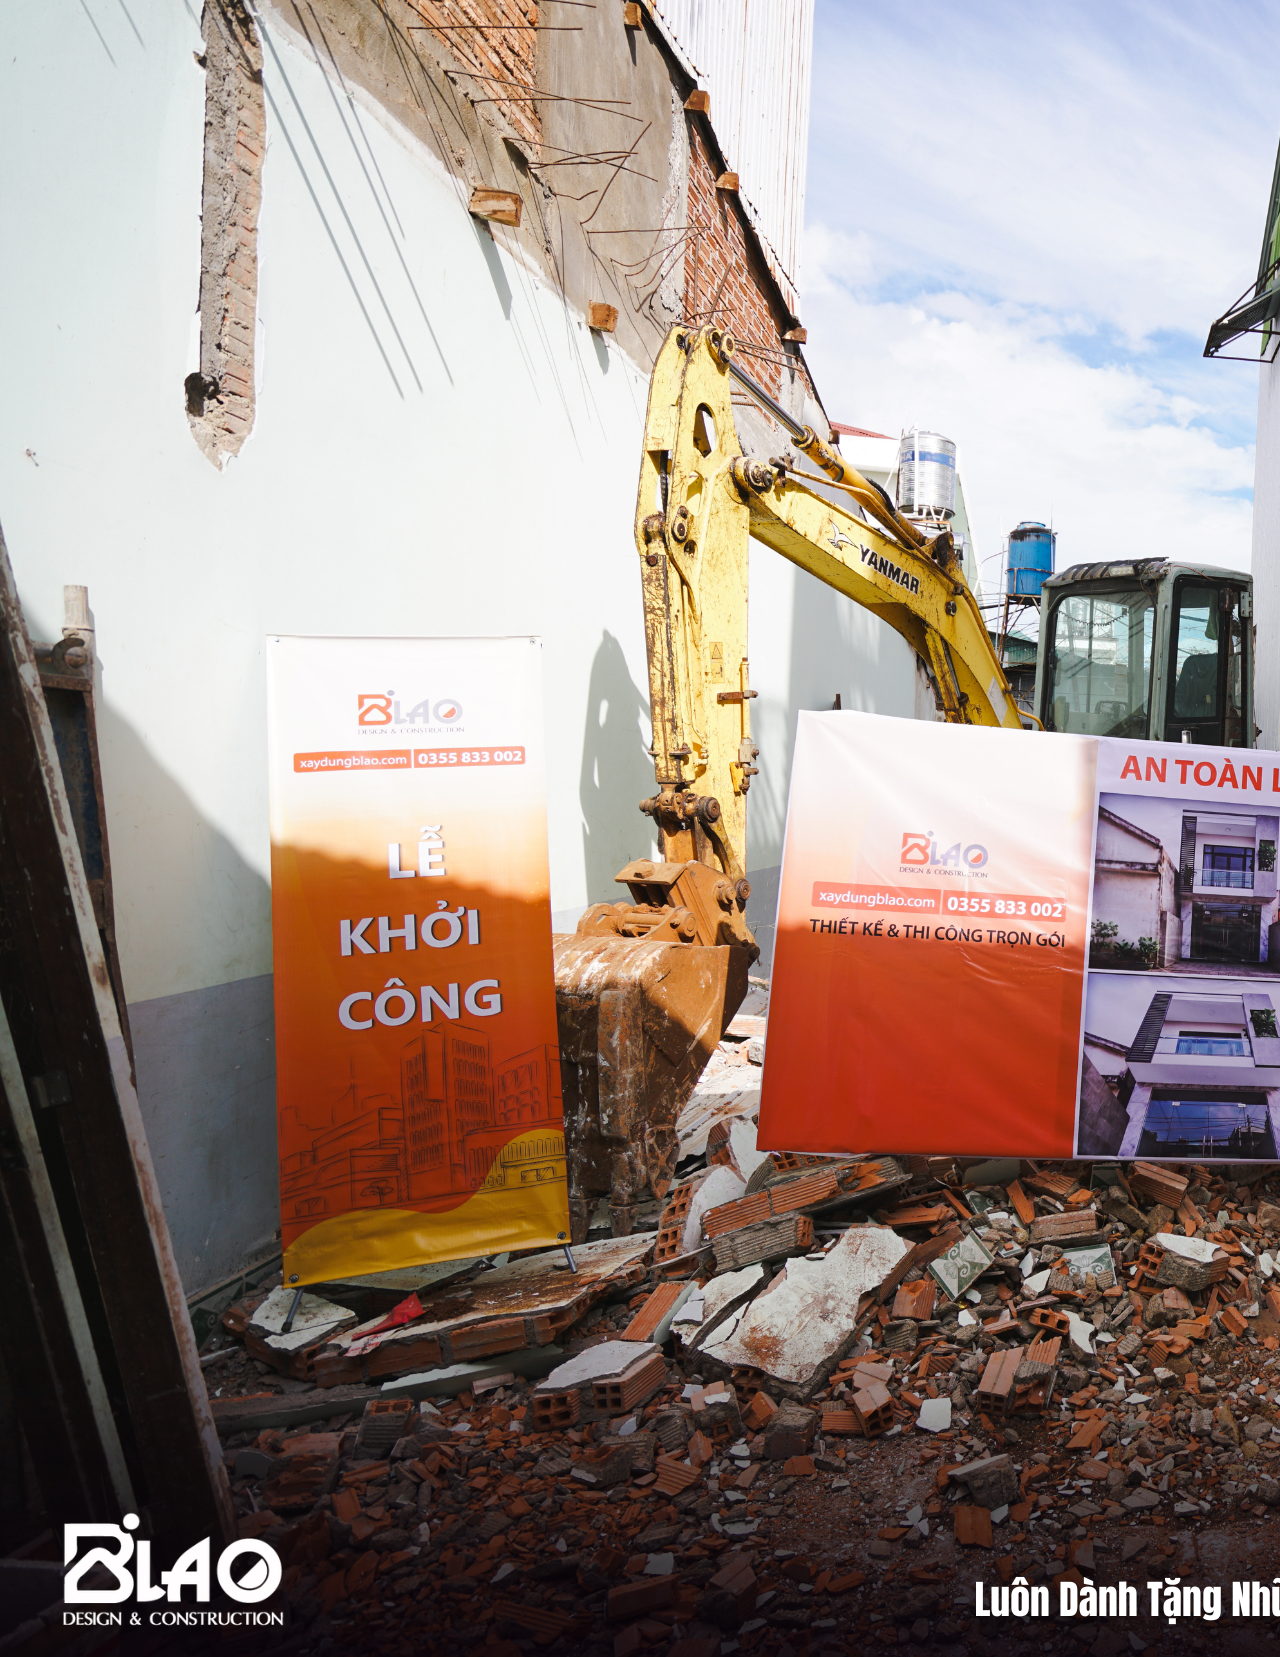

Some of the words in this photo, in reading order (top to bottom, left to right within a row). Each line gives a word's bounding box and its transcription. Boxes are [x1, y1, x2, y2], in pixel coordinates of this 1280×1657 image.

[859, 543, 920, 595] YANMAR
[400, 727, 465, 735] CONSTRUCTION
[300, 756, 407, 770] xaydungblao.com
[418, 752, 457, 765] 0355
[461, 751, 490, 763] 833
[494, 750, 522, 762] 002
[1120, 755, 1167, 783] AN
[1174, 758, 1263, 791] TOÀN
[388, 825, 446, 879] LỄ
[934, 869, 988, 878] CONSTRUCTION
[819, 890, 935, 910] xaydungblao.com
[947, 896, 991, 914] 0355
[994, 898, 1026, 915] 833
[1030, 901, 1063, 918] 002
[339, 900, 481, 957] KHỞI
[810, 916, 859, 936] THIẾT
[862, 919, 884, 937] KẾ
[887, 923, 900, 938] &
[903, 924, 930, 940] THI
[934, 925, 983, 943] CÔNG
[986, 930, 1032, 949] TRỌN
[1036, 931, 1065, 948] GÓI
[338, 978, 503, 1030] CÔNG
